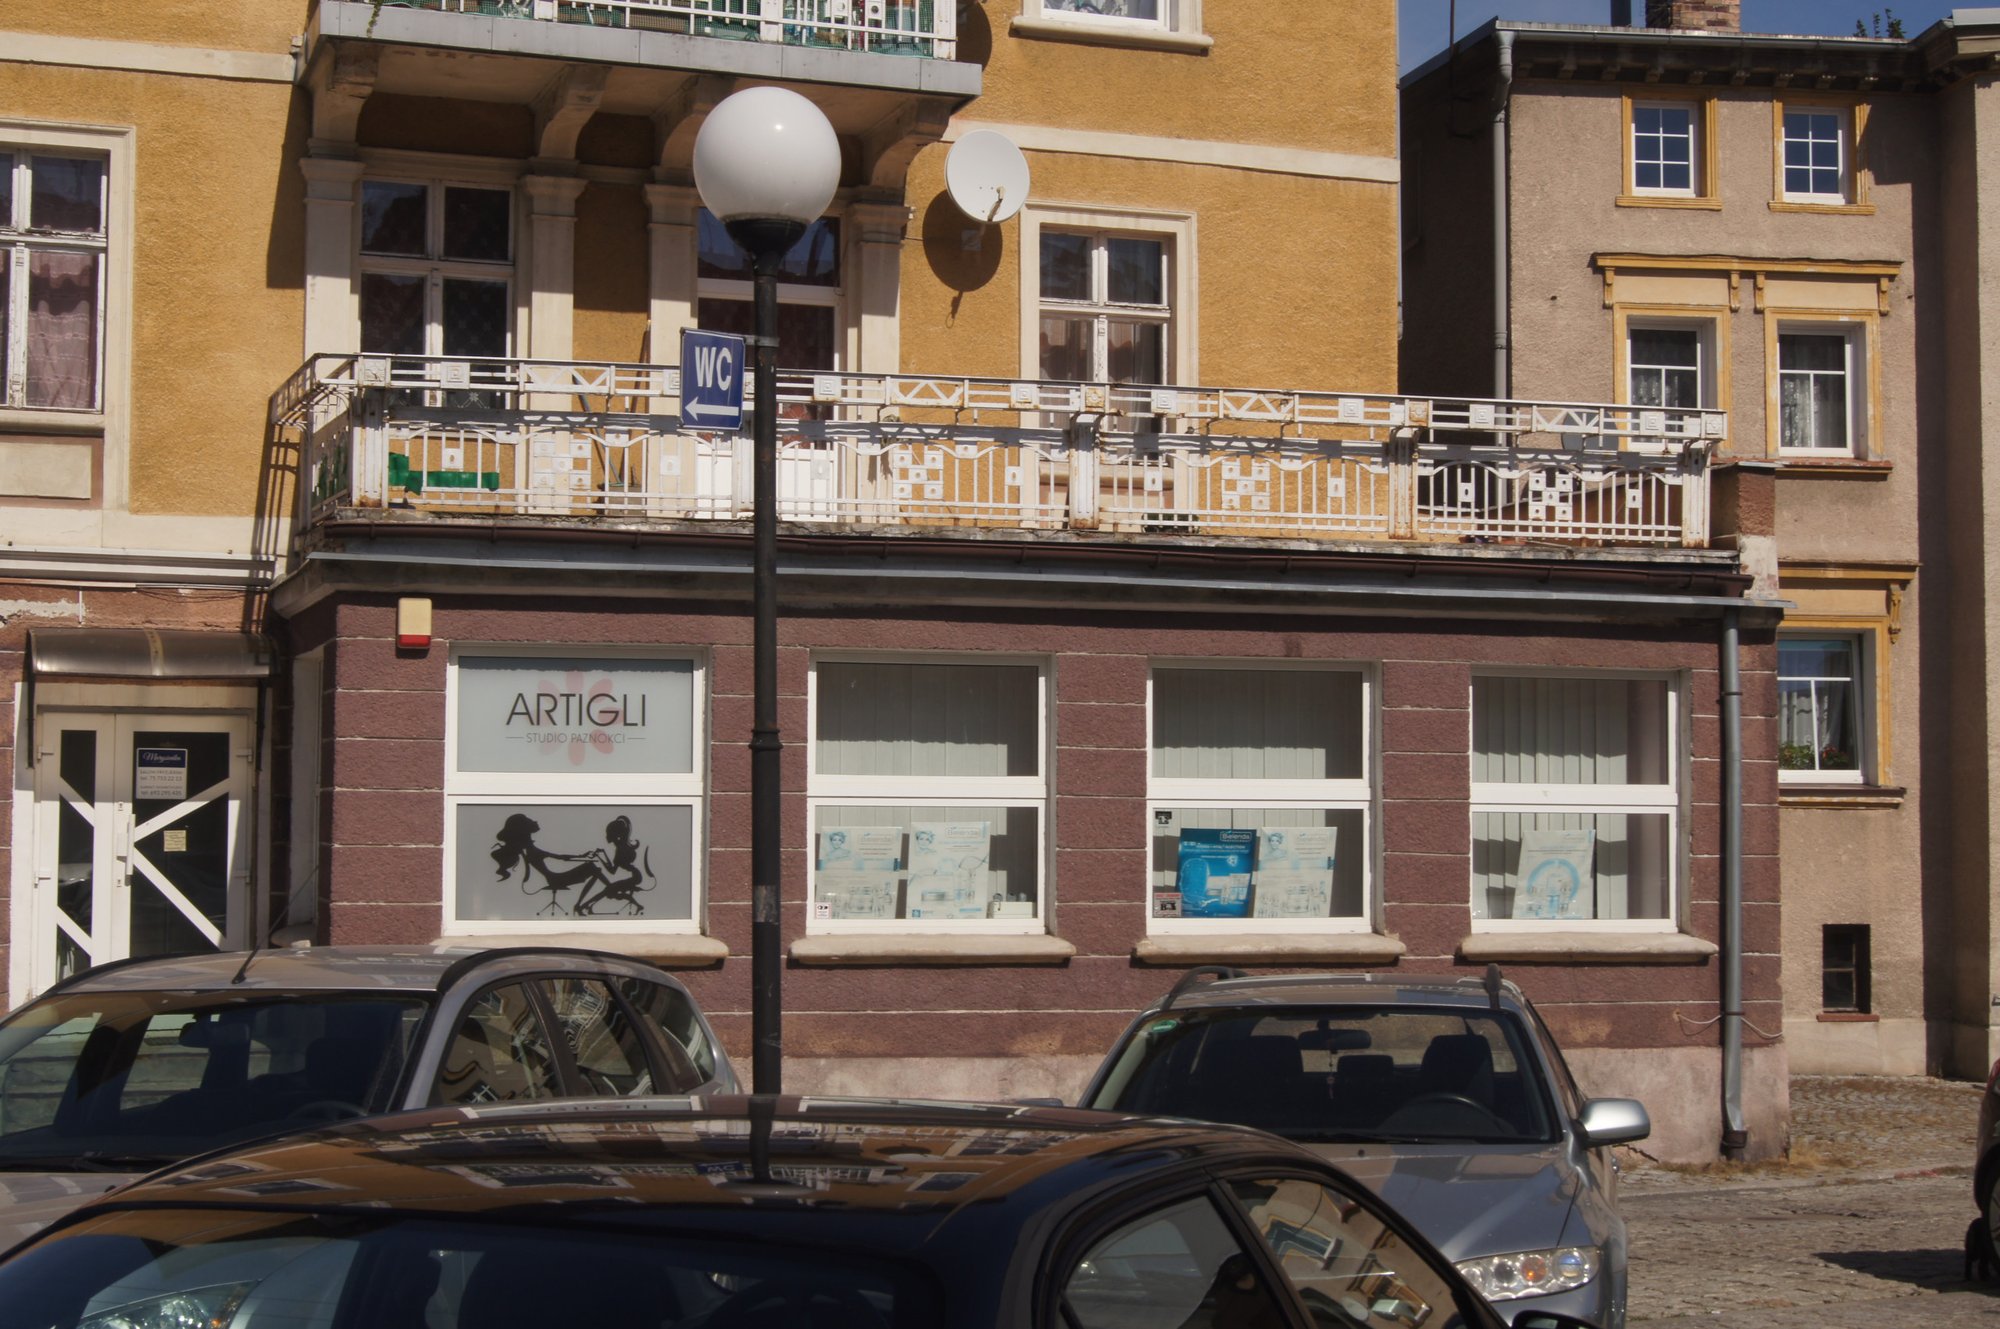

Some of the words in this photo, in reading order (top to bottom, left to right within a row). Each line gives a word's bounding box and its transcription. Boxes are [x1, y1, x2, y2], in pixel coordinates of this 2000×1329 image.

[695, 346, 732, 391] WC
[506, 693, 646, 727] ARTIGLI
[526, 732, 567, 743] STUDIO
[571, 733, 626, 744] PAZNOKCI
